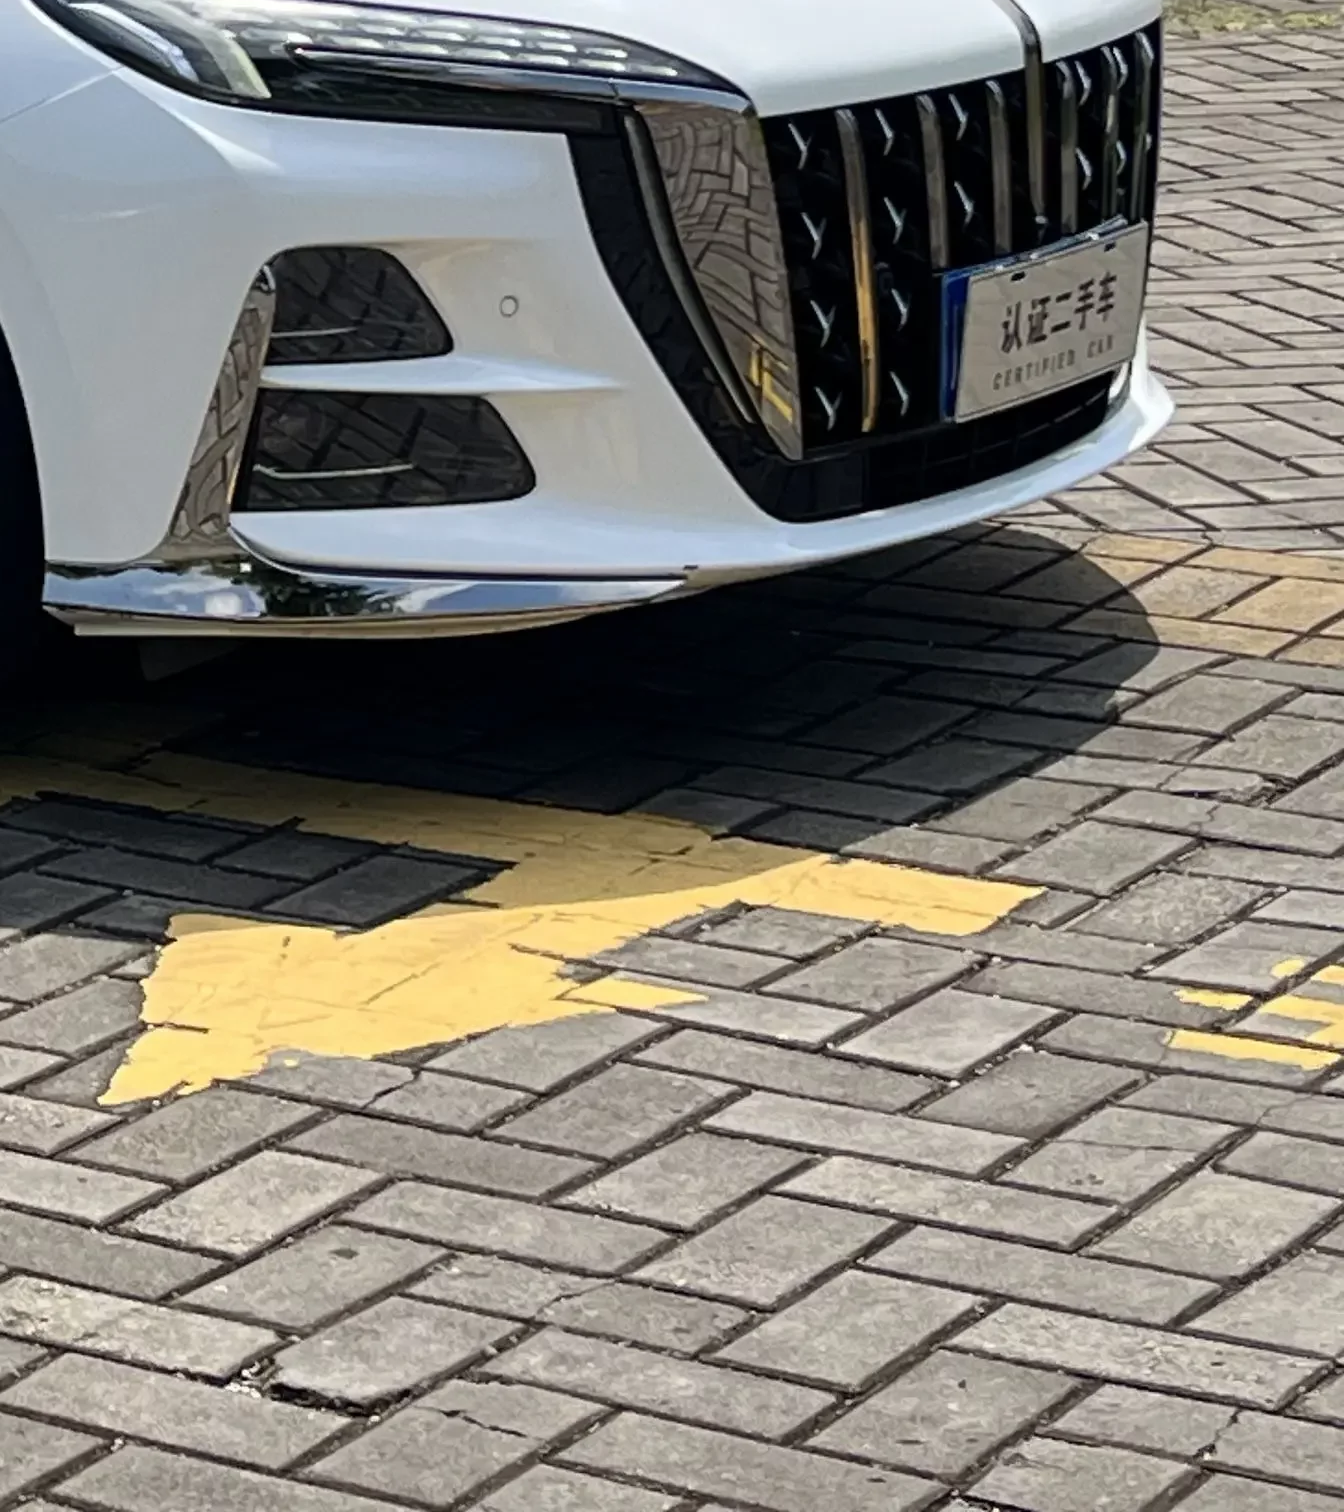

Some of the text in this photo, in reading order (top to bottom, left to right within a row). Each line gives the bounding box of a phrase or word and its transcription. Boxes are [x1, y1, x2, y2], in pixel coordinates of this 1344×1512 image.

[1000, 271, 1117, 354] 认证二手车
[992, 349, 1075, 390] CERTIFIED
